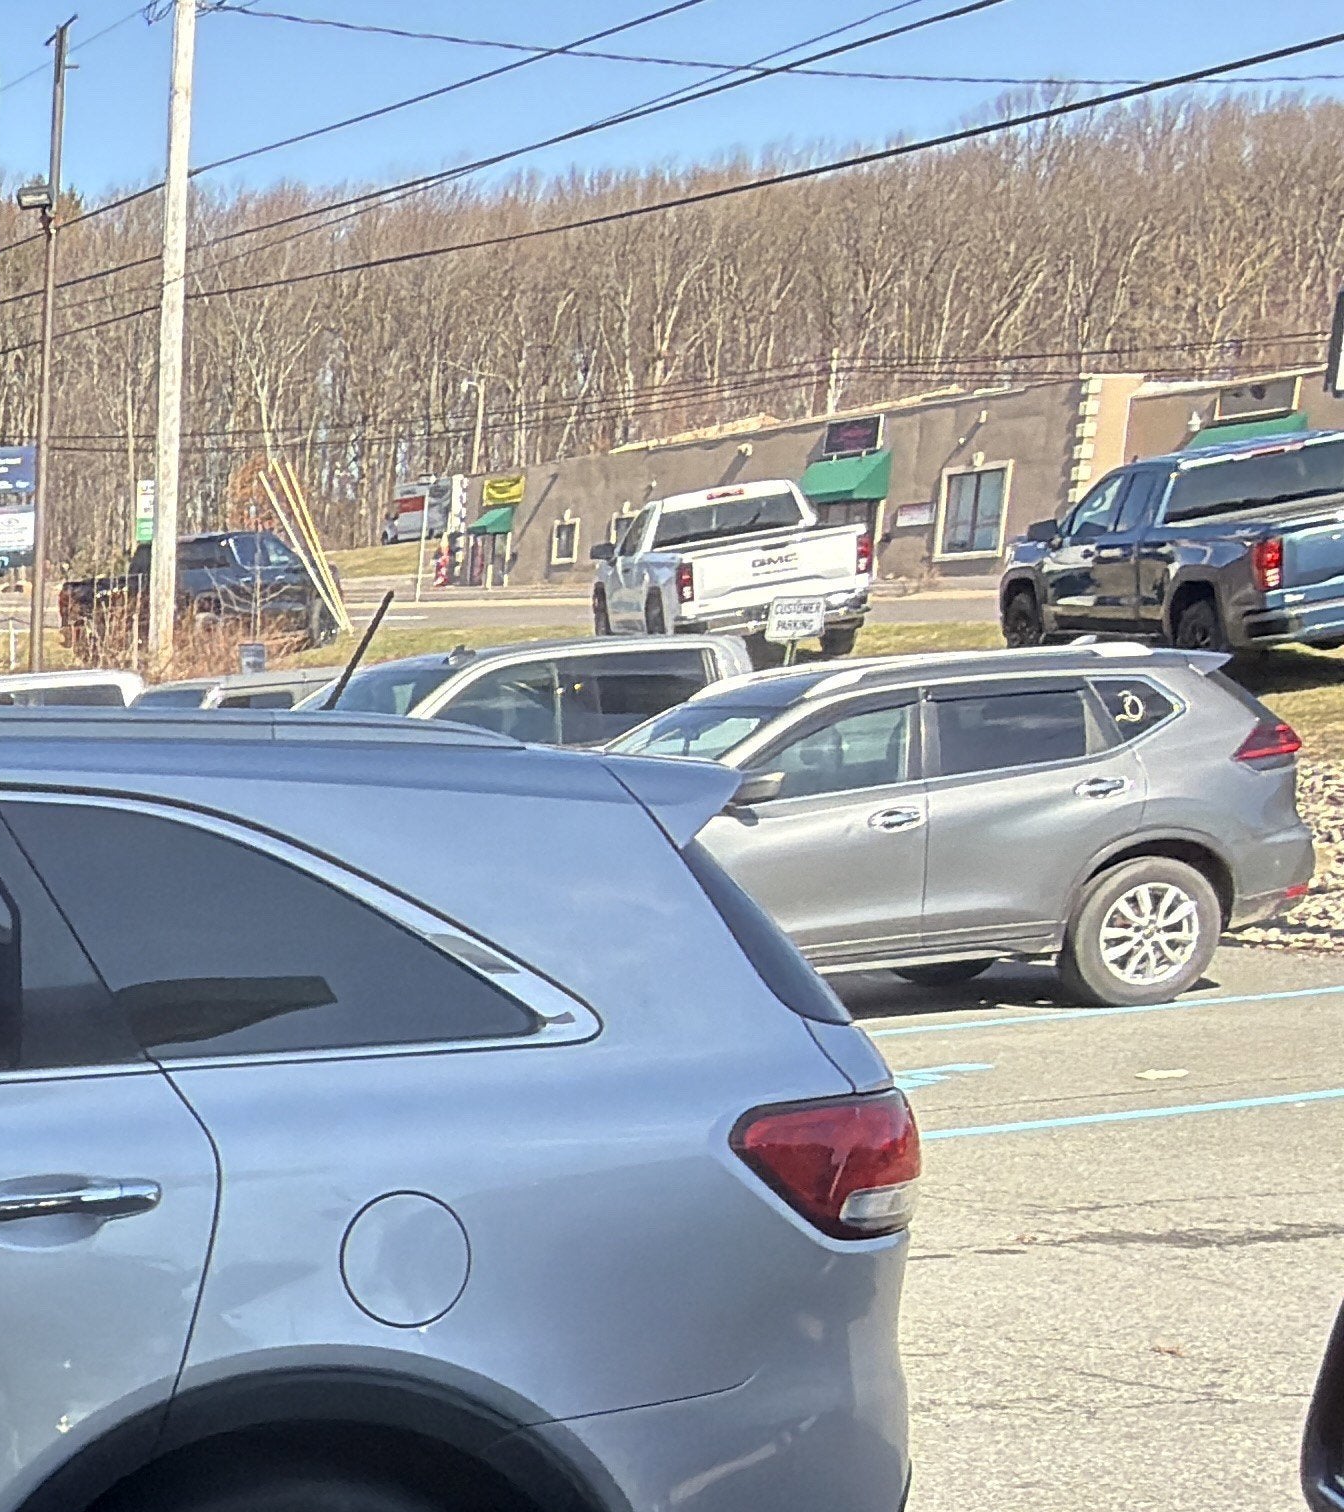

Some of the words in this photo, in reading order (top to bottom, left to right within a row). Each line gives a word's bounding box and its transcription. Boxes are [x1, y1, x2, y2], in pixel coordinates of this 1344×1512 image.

[752, 552, 798, 568] GMC
[774, 602, 821, 615] CUSTOMER
[776, 619, 815, 632] PARKING
